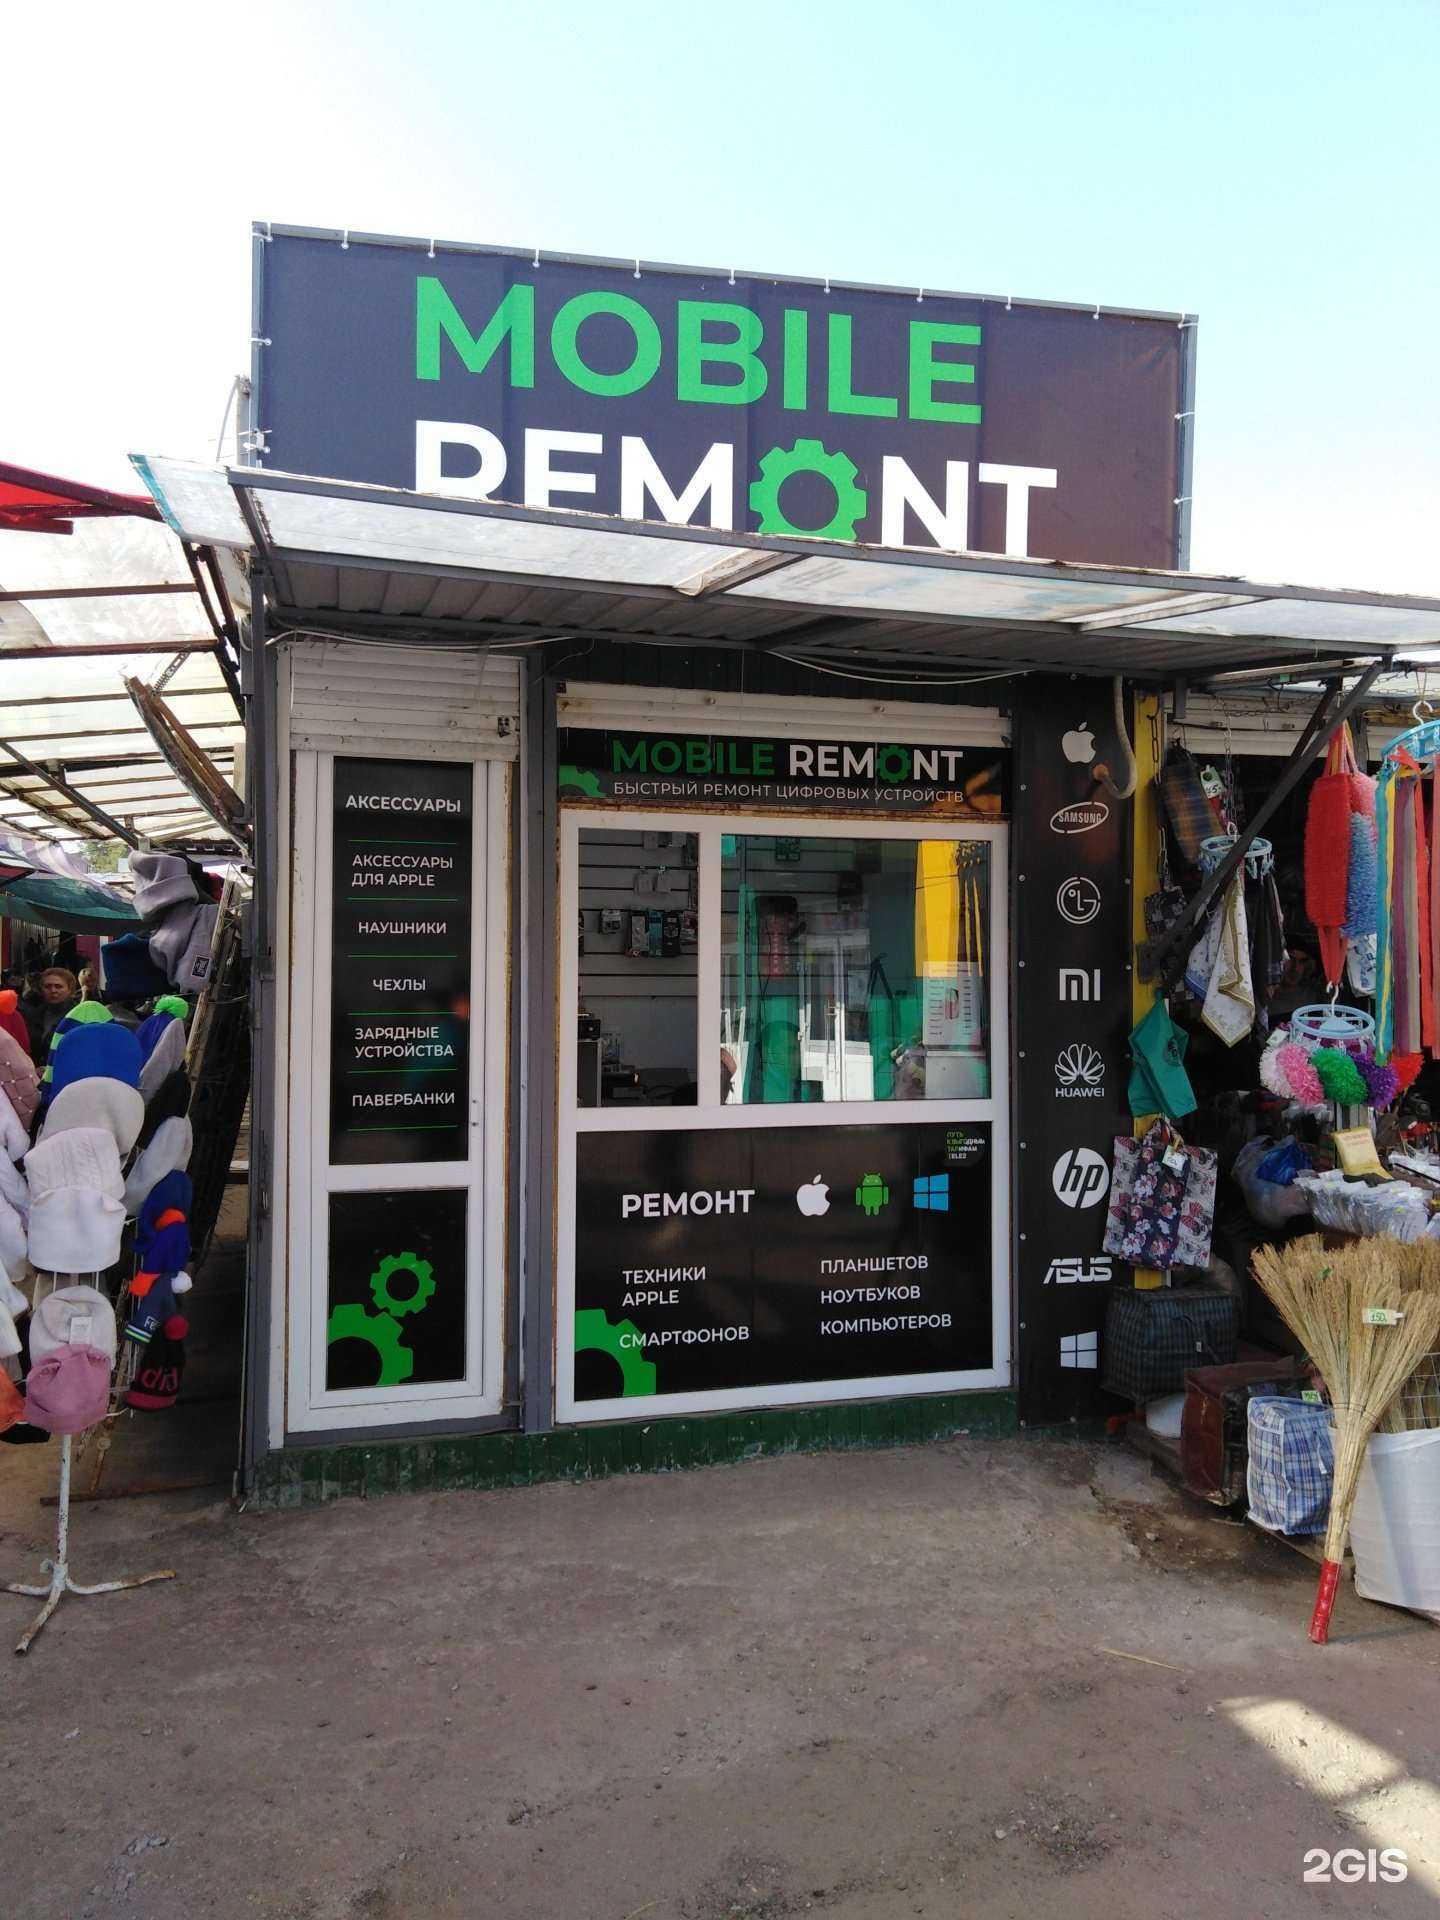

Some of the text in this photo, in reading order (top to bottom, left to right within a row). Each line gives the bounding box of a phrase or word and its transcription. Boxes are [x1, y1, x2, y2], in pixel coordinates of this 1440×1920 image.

[415, 276, 983, 425] MOBILE
[612, 739, 964, 783] MOBILE REMONT
[613, 780, 964, 803] БЫСТРЫЙ РЕМОНТ ЦИФРОВЫХ УСТРОЙСТВ
[345, 795, 461, 813] АКСЕССУАРЫ
[1058, 812, 1102, 825] SAMSUNG
[352, 855, 453, 869] АКСЕССУАРЫ
[351, 873, 435, 888] ДЛЯ APPLE
[358, 922, 447, 935] НАУШНИКИ
[373, 978, 426, 992] ЧЕХЛЫ
[355, 1026, 440, 1041] ЗАРЯДНЫЕ
[355, 1040, 454, 1058] УСТРОЙСТВА
[352, 1093, 455, 1108] ПАВЕРБАНКИ
[1055, 1088, 1105, 1097] HUAWEI
[1056, 1148, 1108, 1209] hp
[621, 1189, 755, 1218] РЕМОНТ
[820, 1255, 929, 1274] ПЛАНШЕТОВ
[1043, 1257, 1112, 1284] ASUS
[622, 1266, 706, 1285] ТЕХНИКИ
[622, 1290, 679, 1307] APPLE
[820, 1286, 921, 1304] НОУТБУКОВ
[820, 1313, 952, 1335] КОМПЬЮТЕРОВ
[619, 1326, 750, 1349] СМАРТФОНОВ
